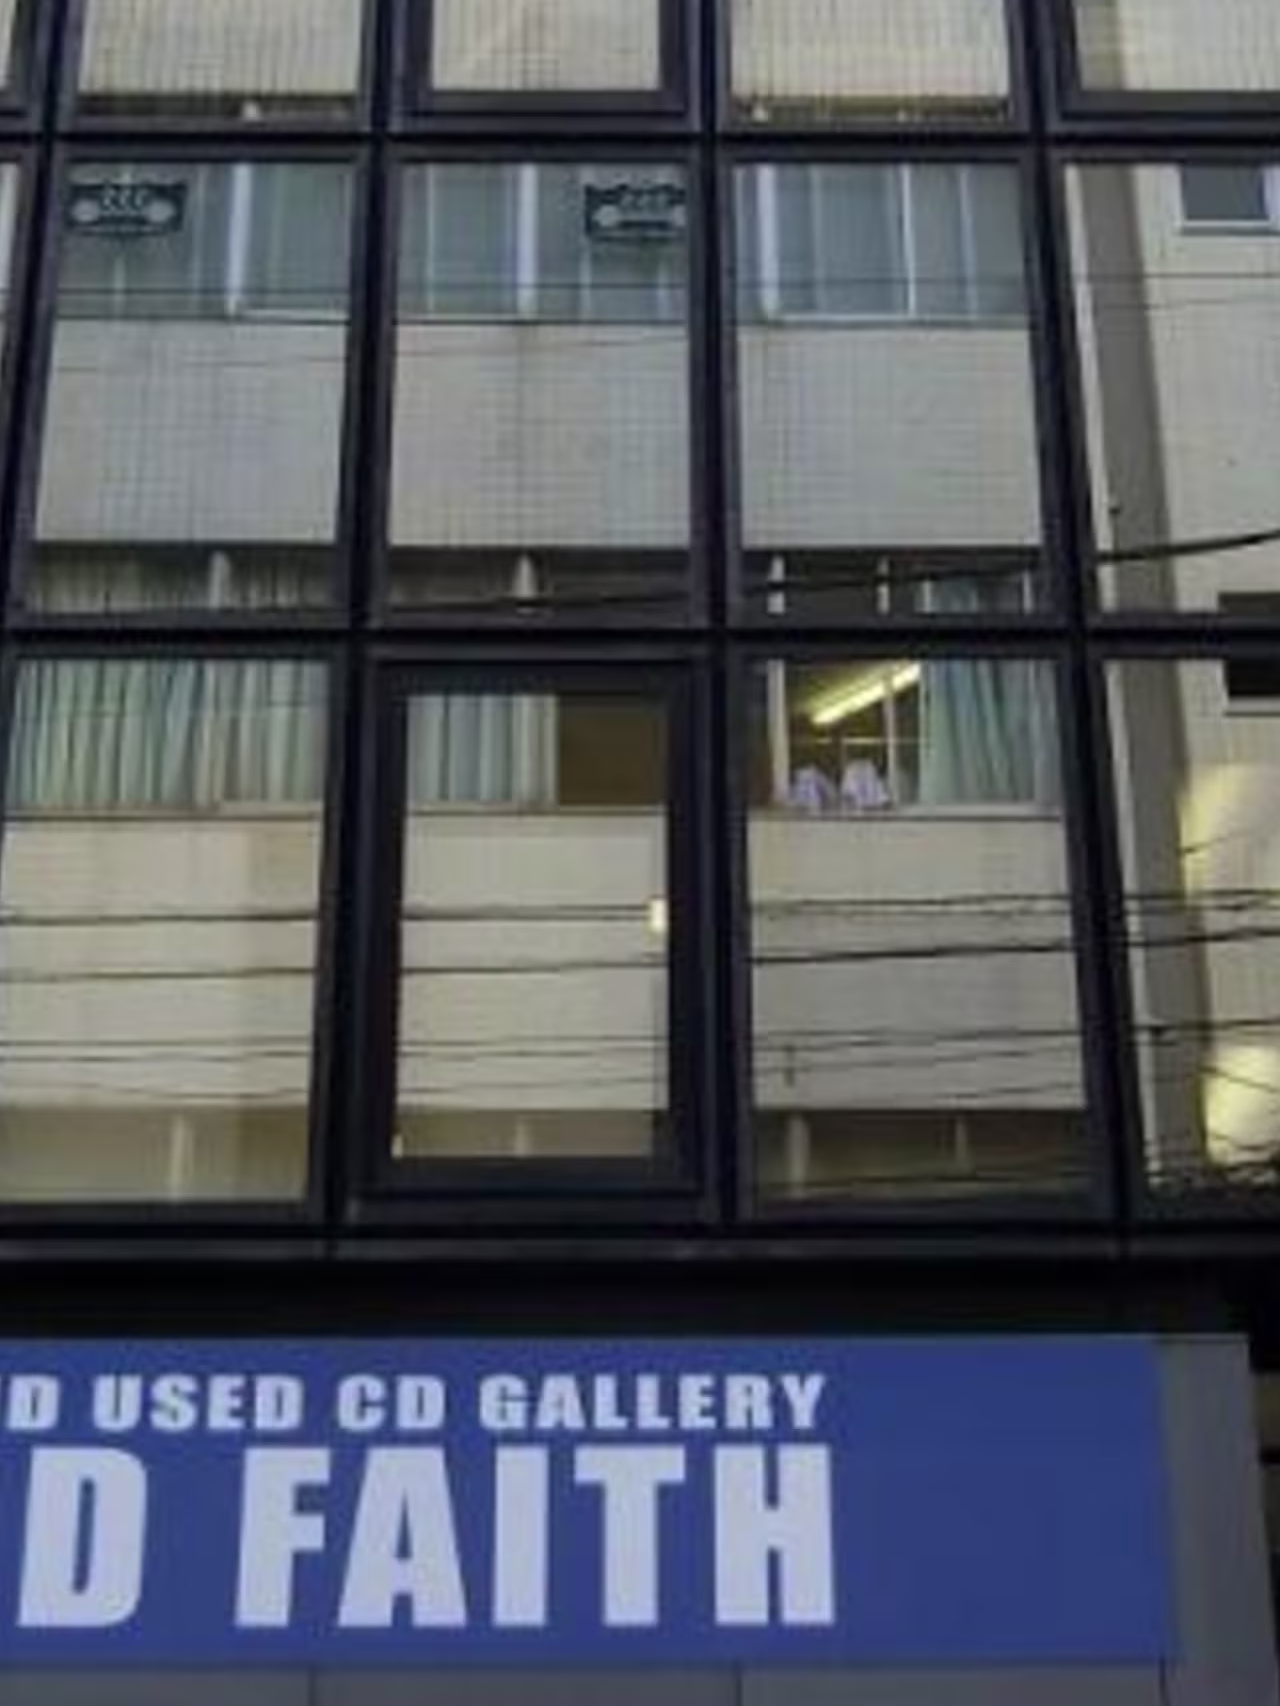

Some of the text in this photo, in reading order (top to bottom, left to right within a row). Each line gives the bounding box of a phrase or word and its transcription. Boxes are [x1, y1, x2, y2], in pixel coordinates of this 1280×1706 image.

[93, 1374, 302, 1431] USED
[338, 1374, 445, 1431] CD
[479, 1374, 825, 1431] GALLERY
[235, 1444, 835, 1628] FAITH
